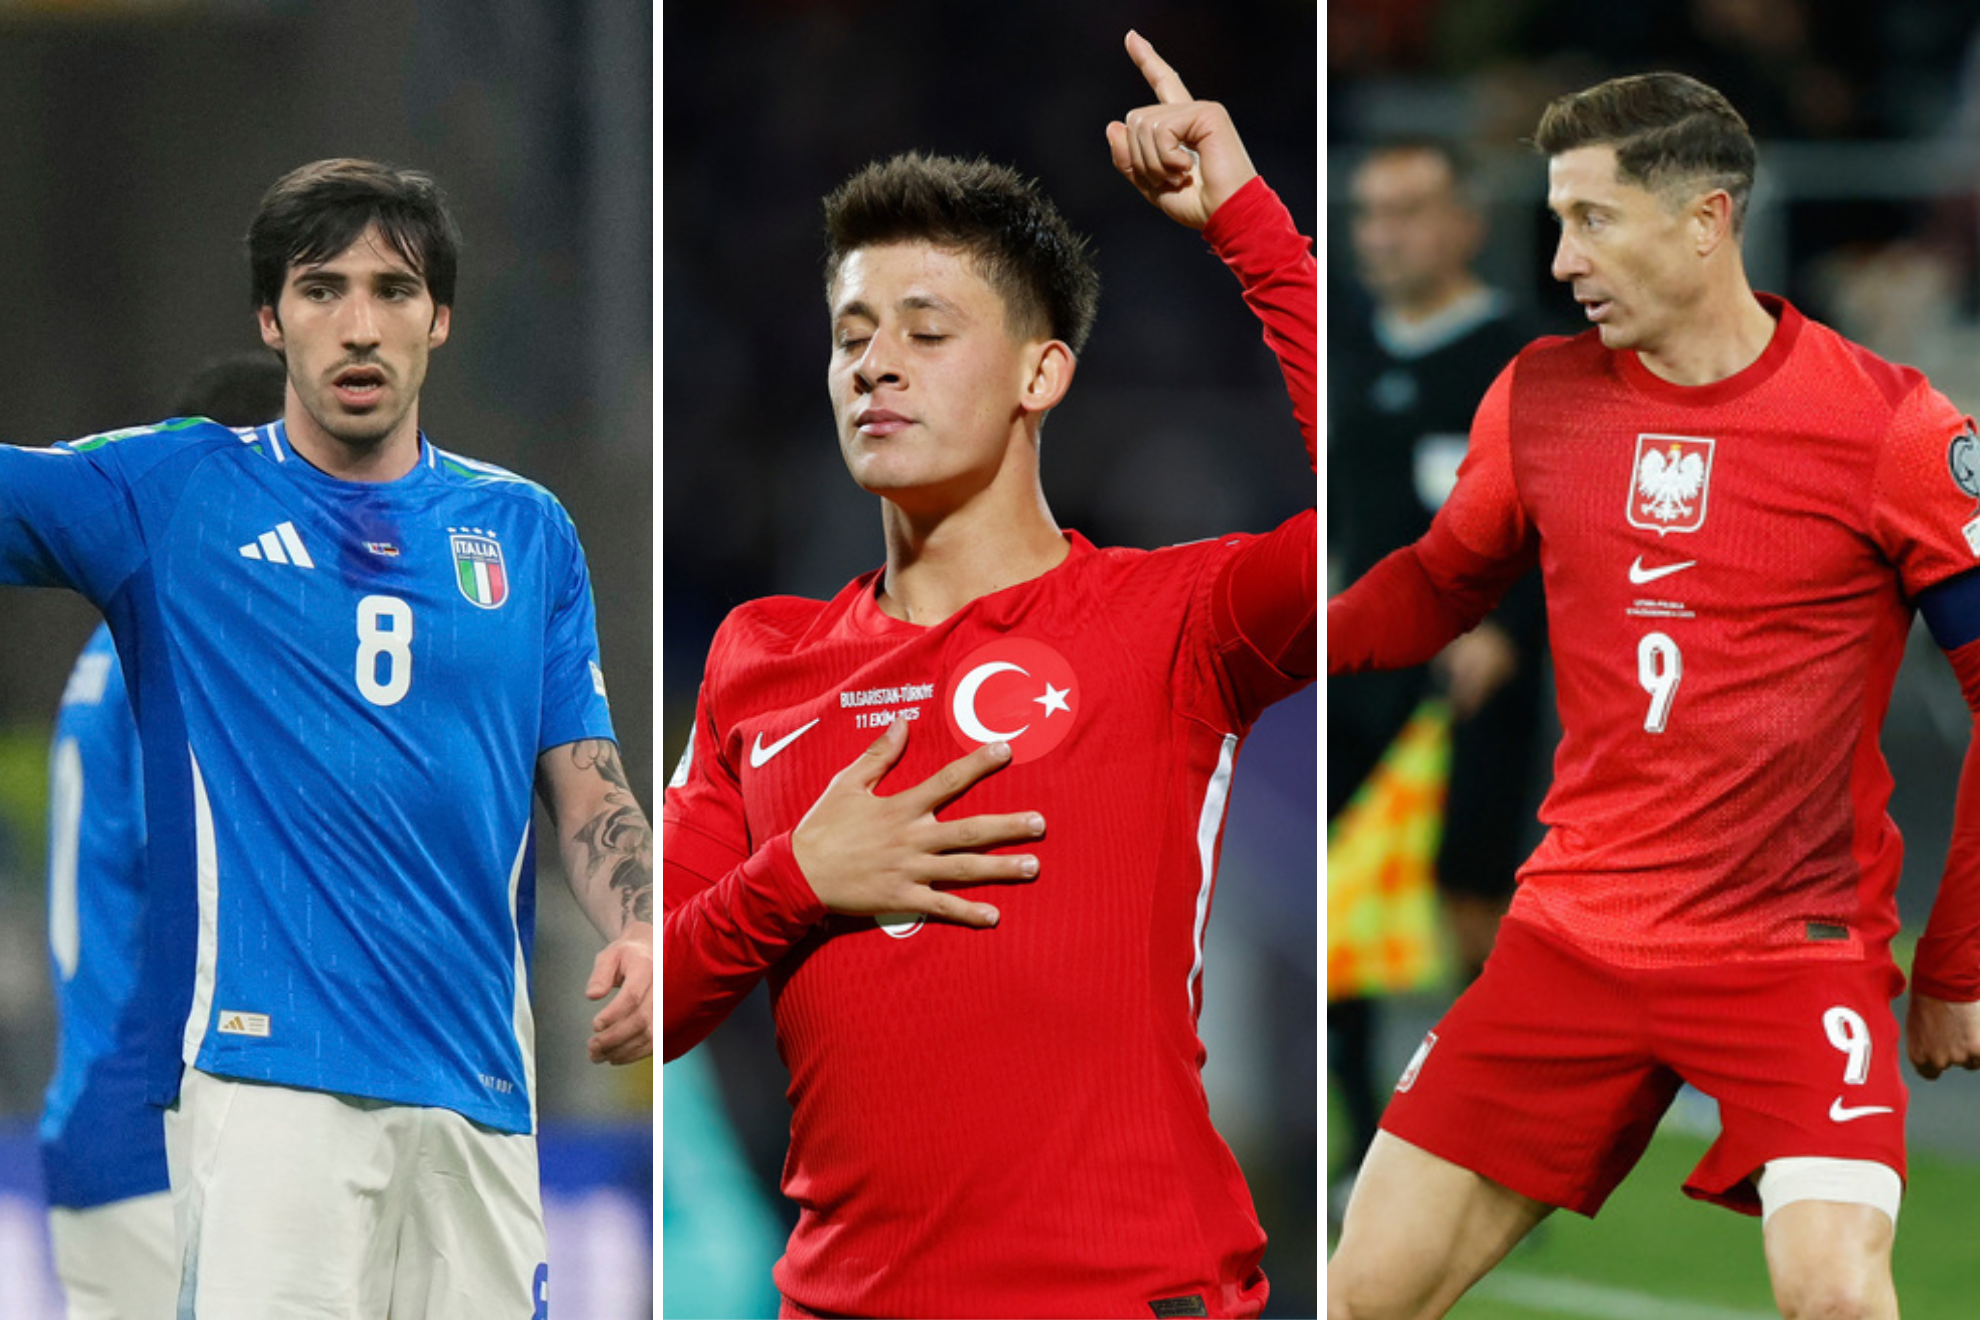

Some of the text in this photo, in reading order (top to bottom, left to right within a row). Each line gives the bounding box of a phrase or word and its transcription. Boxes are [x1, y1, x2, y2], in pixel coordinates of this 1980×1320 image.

[455, 540, 498, 557] ITALIA
[355, 595, 414, 706] 8
[1637, 630, 1683, 733] 9
[856, 712, 867, 729] 11
[1822, 1005, 1872, 1085] 9
